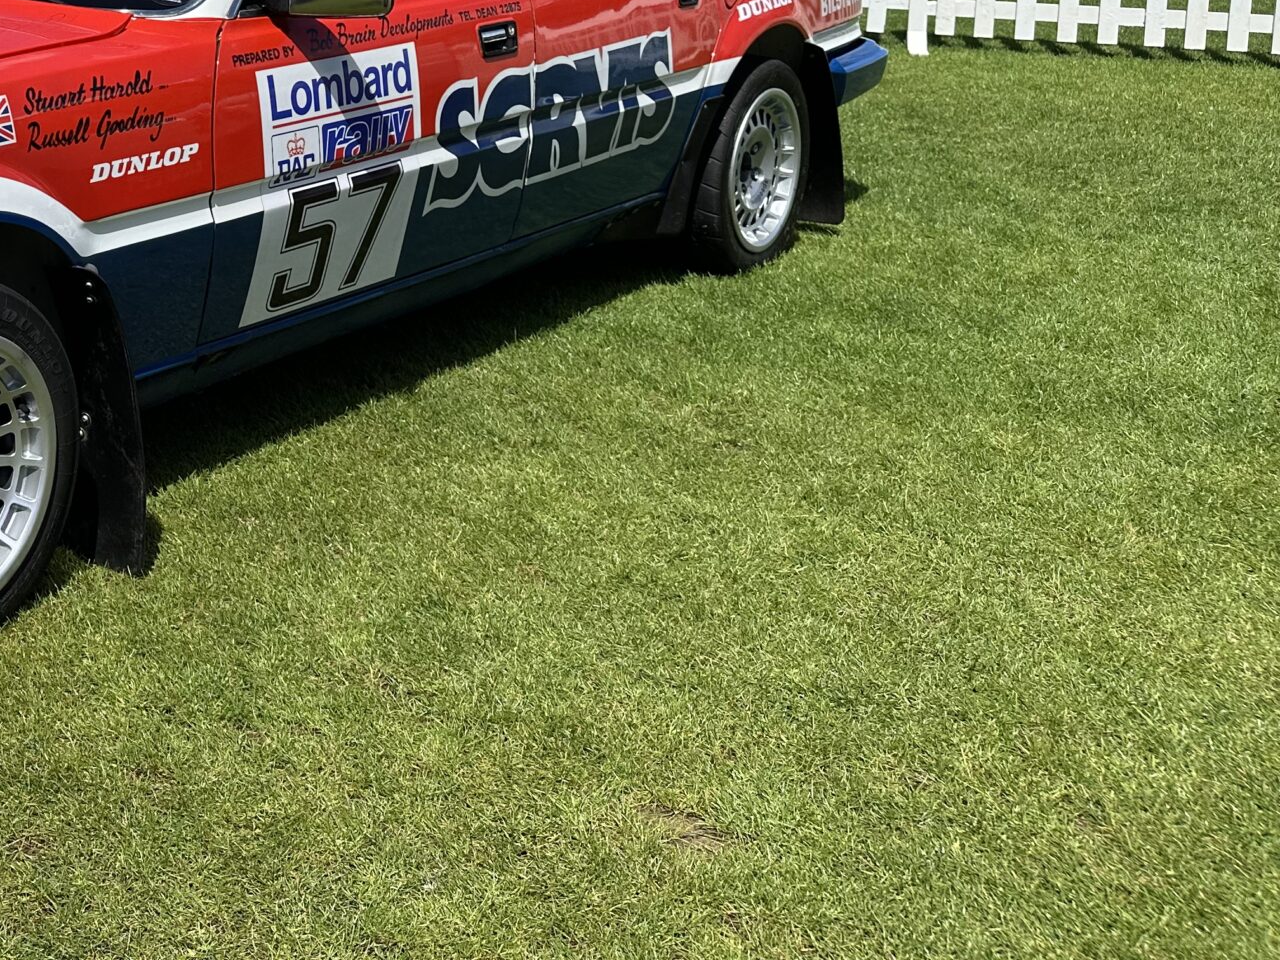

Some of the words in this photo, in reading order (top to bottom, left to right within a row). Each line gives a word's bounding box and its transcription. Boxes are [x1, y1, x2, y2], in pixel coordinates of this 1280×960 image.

[232, 49, 280, 68] PREPARED
[282, 45, 295, 58] BY
[336, 22, 377, 50] Brain
[380, 8, 454, 39] Developments
[476, 5, 498, 19] DEAN
[23, 83, 87, 115] Stuart
[90, 70, 154, 102] Harold
[267, 48, 412, 121] Lombard
[27, 116, 91, 152] Russell
[96, 106, 165, 151] Gooding
[273, 152, 316, 184] RAC
[320, 107, 413, 169] rally
[90, 142, 200, 184] DUNLOP
[266, 159, 404, 312] 57
